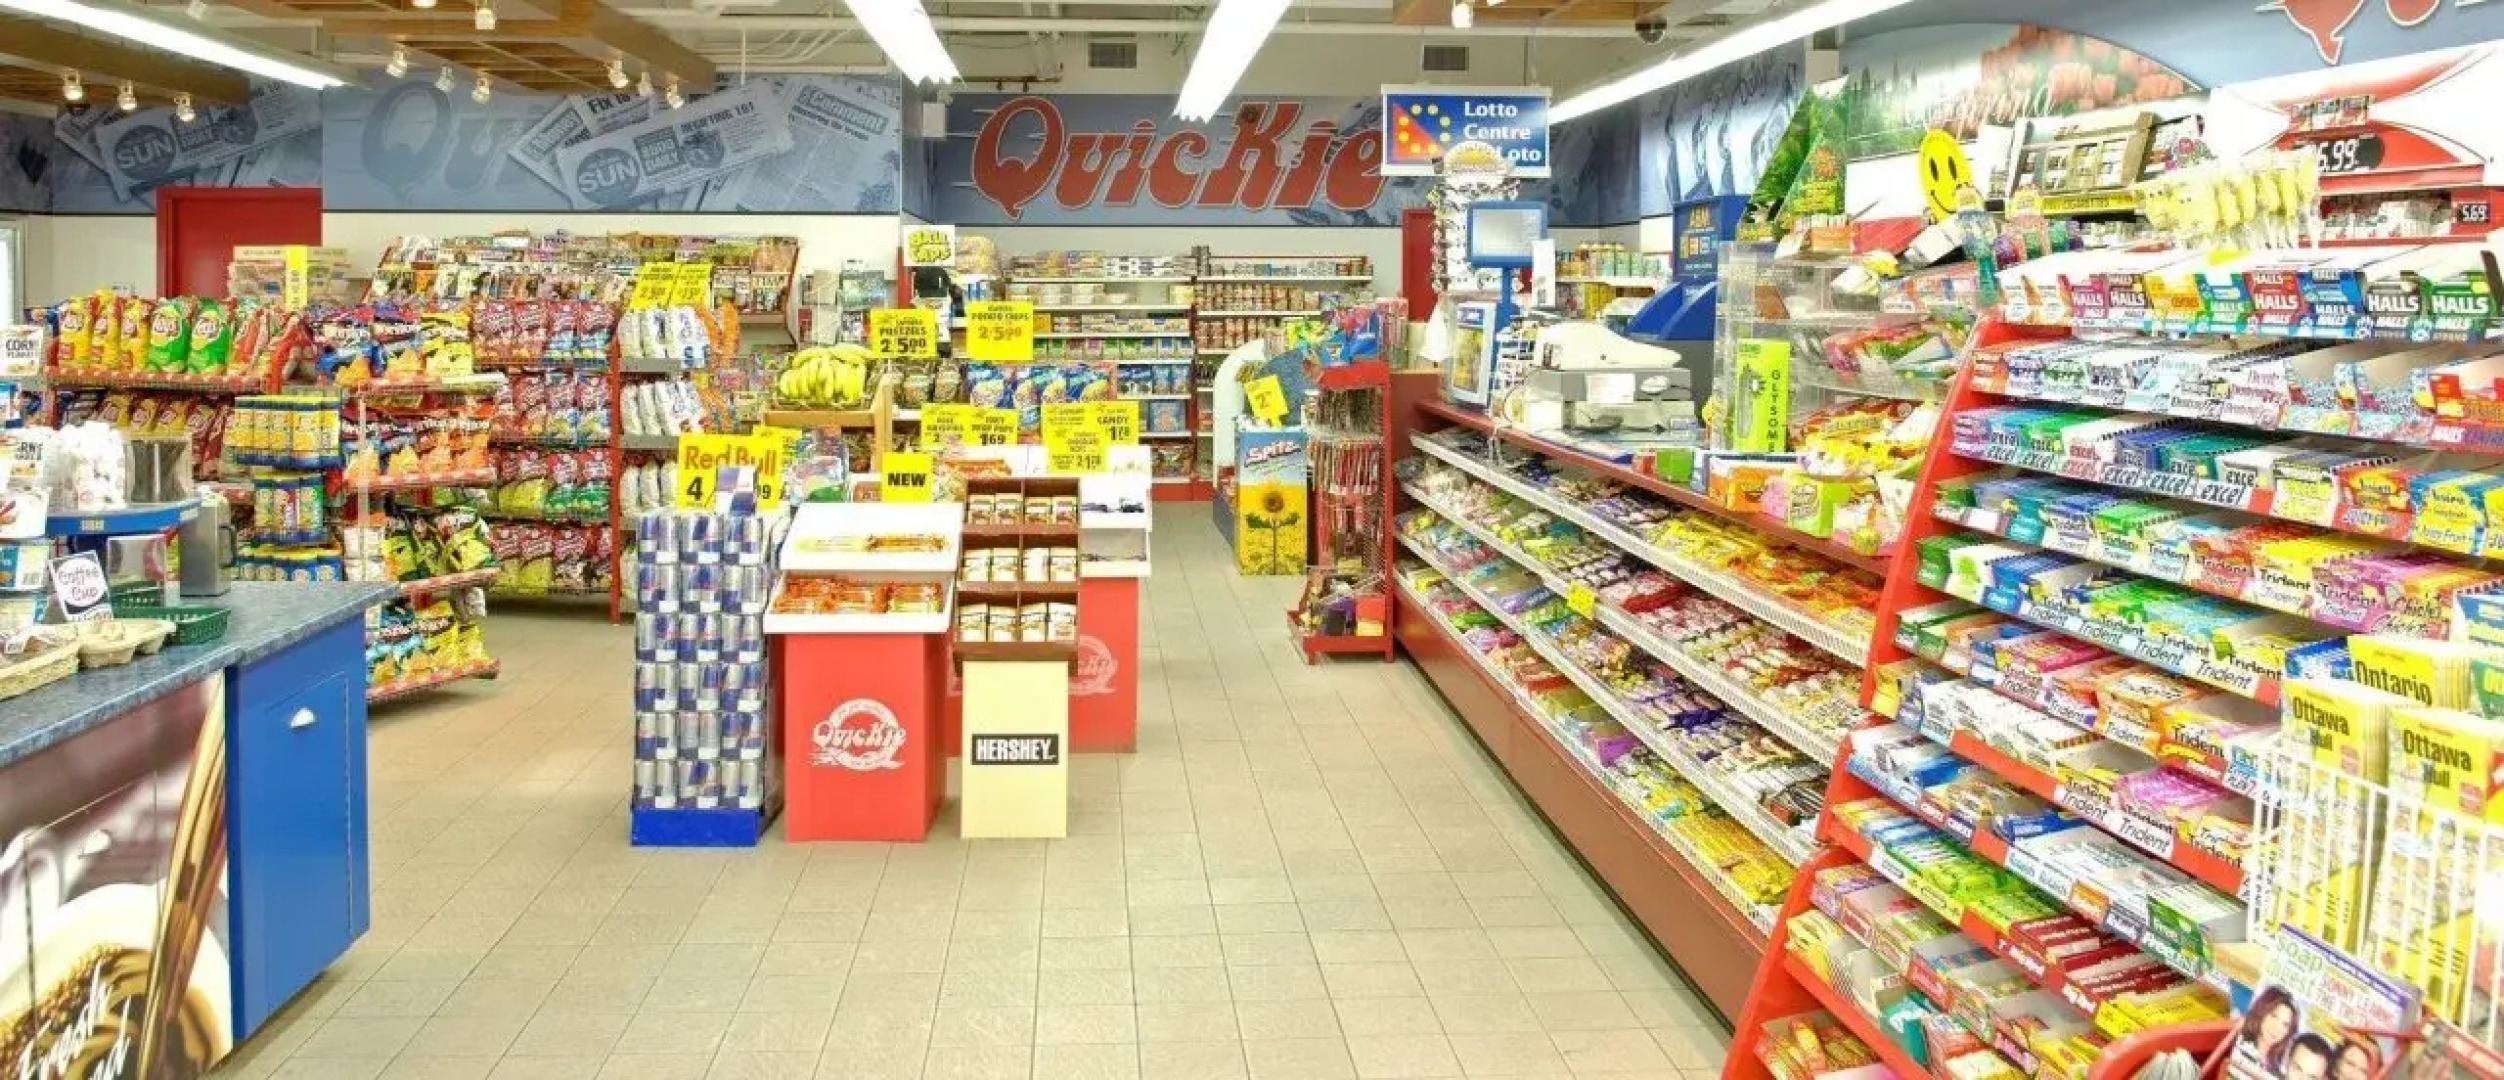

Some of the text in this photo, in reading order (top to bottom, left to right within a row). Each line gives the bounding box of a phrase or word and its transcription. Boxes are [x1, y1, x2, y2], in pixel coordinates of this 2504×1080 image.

[1464, 101, 1518, 117] Lotto
[1463, 123, 1532, 141] Centre
[115, 134, 175, 169] SUN
[972, 97, 1387, 221] QuicKie
[578, 158, 638, 192] SUN
[2073, 292, 2103, 306] HALLS
[2110, 292, 2144, 307] HALLS
[2255, 295, 2298, 310] HALLS
[2316, 304, 2355, 317] HALLS
[2368, 295, 2419, 312] HALLS
[2432, 296, 2488, 314] HALLS
[1097, 416, 1130, 426] CANDY
[685, 444, 731, 470] Red
[887, 472, 927, 489] NEW
[2104, 464, 2141, 485] excel
[2150, 474, 2187, 494] excel
[2200, 483, 2245, 505] excel
[59, 566, 99, 585] Coffee
[2260, 568, 2311, 591] Trident
[72, 587, 98, 601] Cup
[2321, 583, 2377, 606] Trident
[2029, 604, 2069, 627] Trident
[2080, 619, 2123, 645] Trident
[2134, 637, 2185, 666] Trident
[2160, 631, 2209, 658] Trident
[2197, 659, 2253, 690] Trident
[2229, 653, 2282, 681] Trident
[2355, 660, 2433, 706] Ontario
[2049, 700, 2085, 724] Trident
[2293, 696, 2350, 736] Ottawa
[2105, 721, 2146, 747] Trident
[2172, 725, 2225, 758] Trident
[2403, 729, 2472, 772] Ottawa
[2061, 789, 2109, 821] Trident
[2118, 817, 2172, 854] Trident
[2190, 834, 2244, 868] Trident
[2275, 933, 2323, 971] soap
